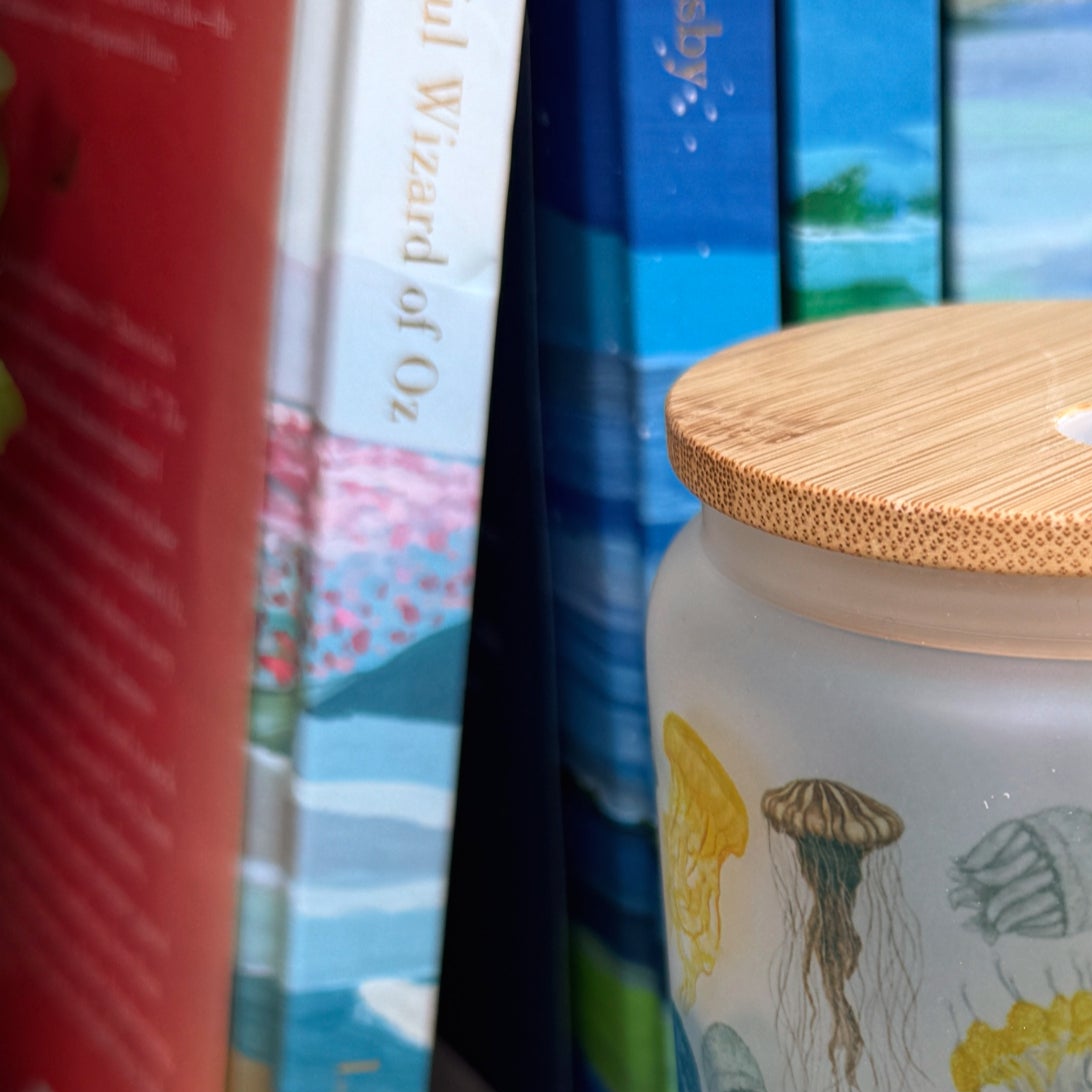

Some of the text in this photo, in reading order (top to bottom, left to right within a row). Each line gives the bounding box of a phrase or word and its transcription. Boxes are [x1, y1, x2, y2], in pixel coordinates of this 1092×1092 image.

[389, 0, 469, 424] ul Wizard of Oz
